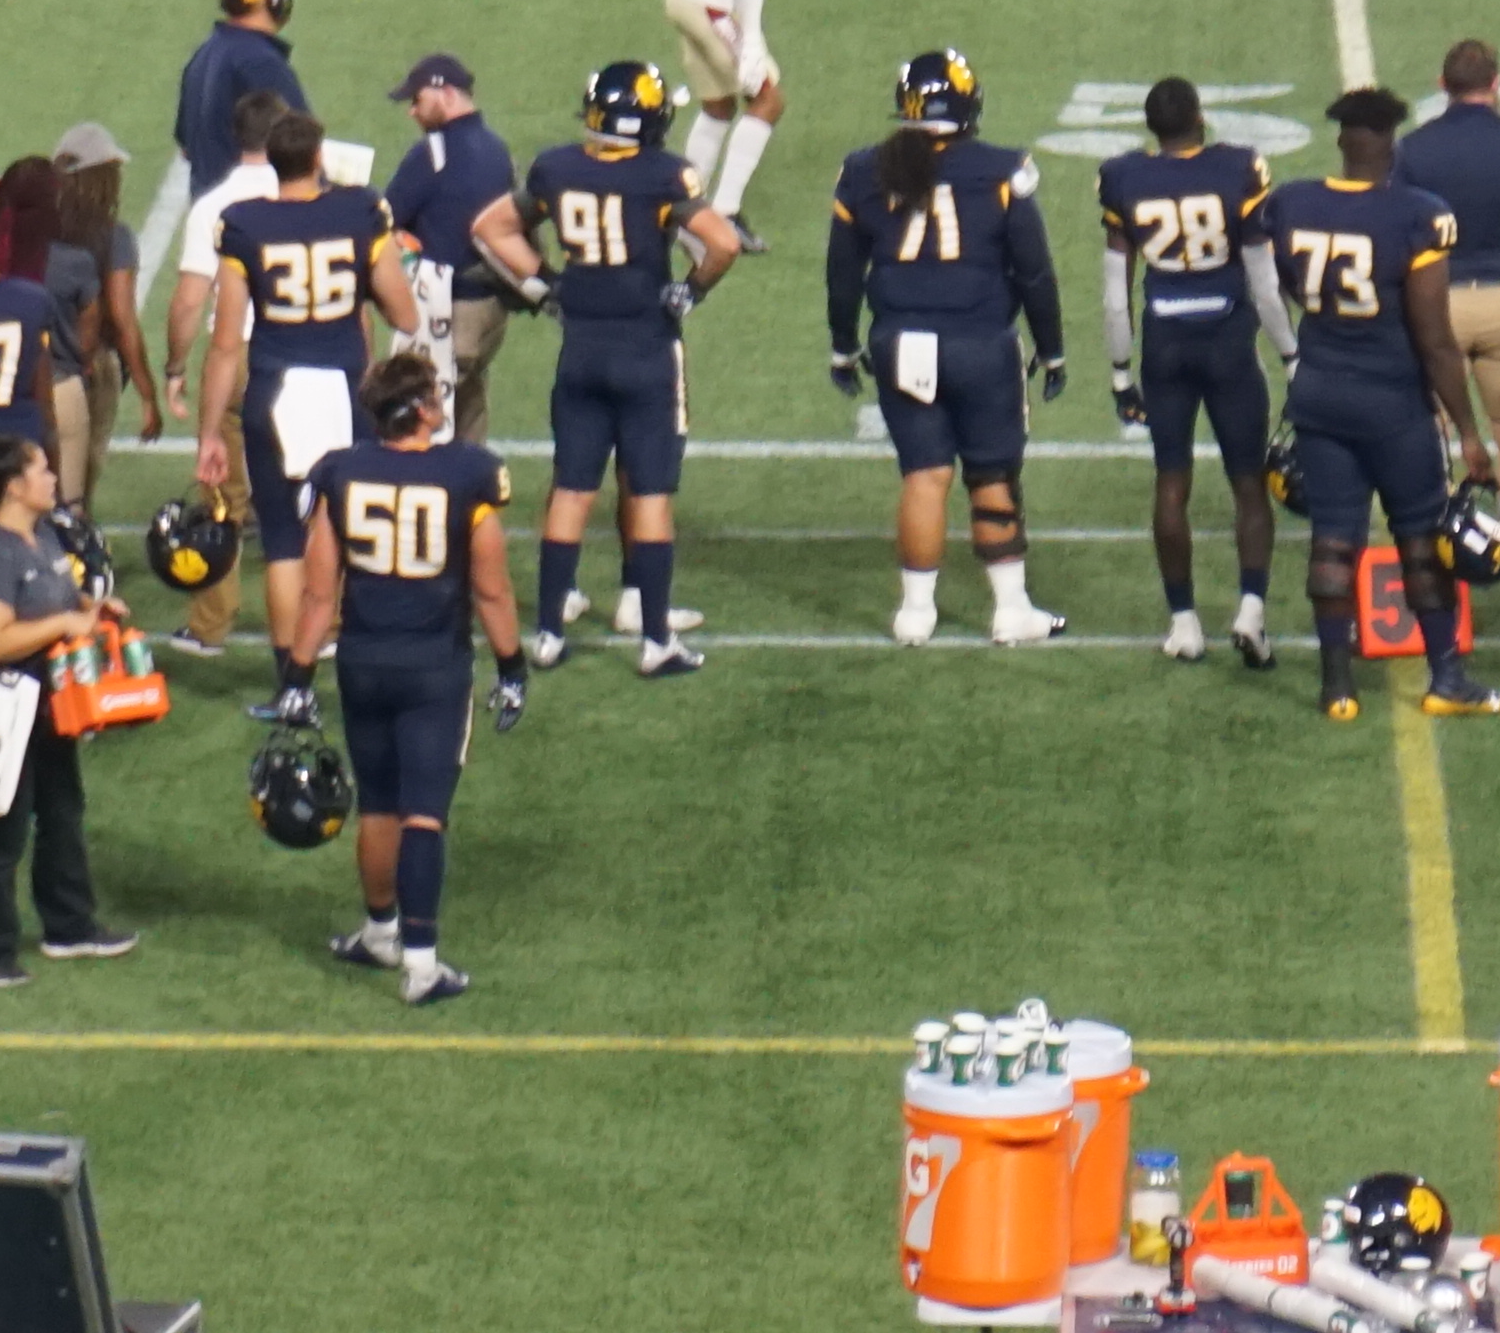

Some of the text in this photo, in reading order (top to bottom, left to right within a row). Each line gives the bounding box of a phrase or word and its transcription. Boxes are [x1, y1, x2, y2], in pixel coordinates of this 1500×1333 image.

[559, 189, 629, 266] 91
[1134, 192, 1232, 273] 28
[259, 236, 358, 325] 36
[1289, 229, 1382, 319] 73
[343, 480, 450, 580] 50
[905, 1137, 930, 1197] G
